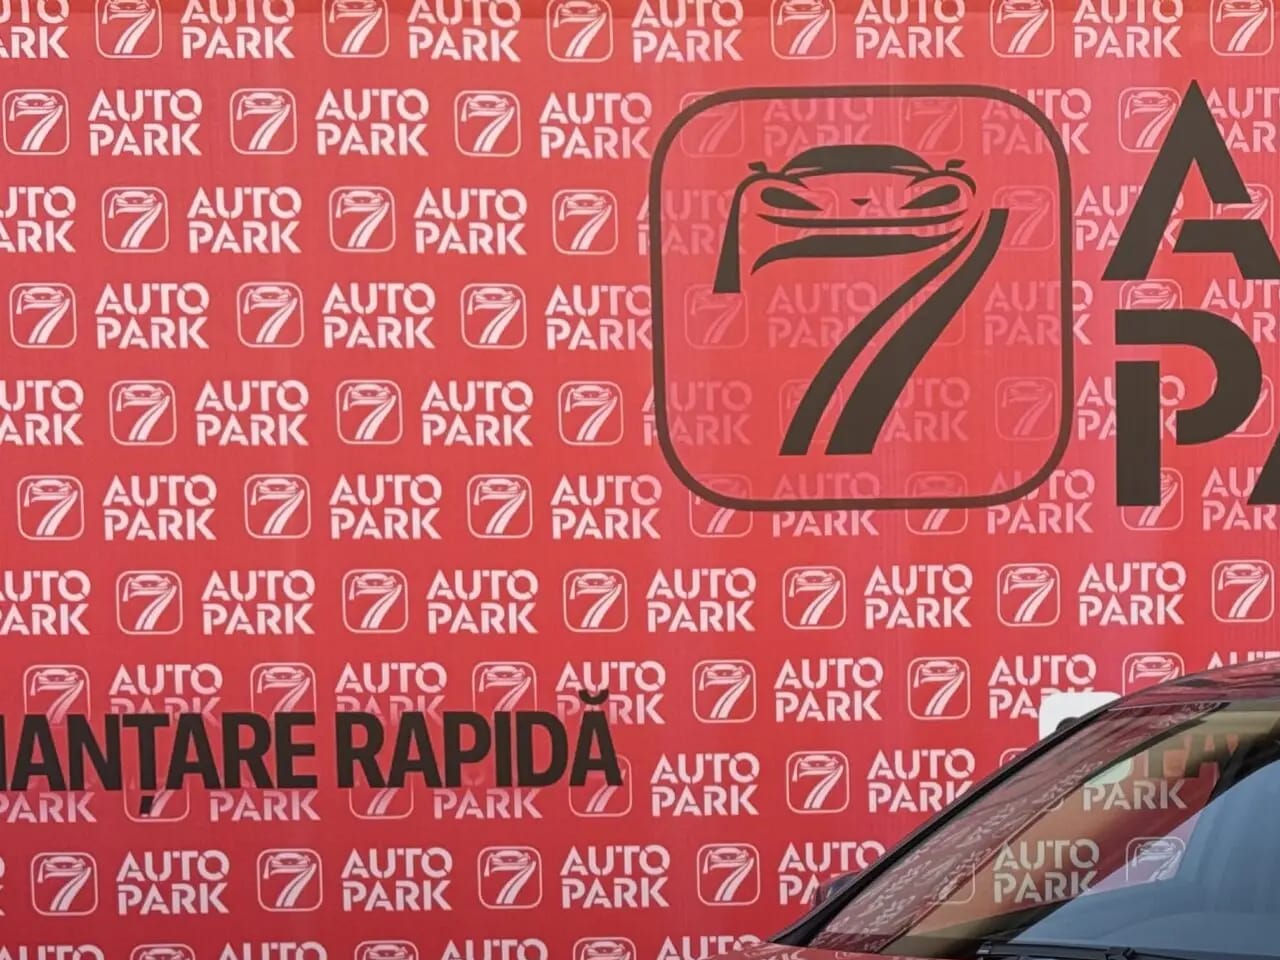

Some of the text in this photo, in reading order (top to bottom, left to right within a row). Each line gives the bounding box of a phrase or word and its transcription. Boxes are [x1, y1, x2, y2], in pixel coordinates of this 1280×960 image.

[180, 0, 295, 24] AUTO
[407, 0, 521, 28] AUTO
[631, 0, 743, 28] AUTO
[854, 0, 965, 24] AUTO
[1072, 0, 1183, 23] AUTO
[182, 26, 294, 59] PARK
[409, 26, 520, 62] PARK
[633, 29, 742, 63] PARK
[856, 26, 963, 58] PARK
[1074, 26, 1181, 57] PARK
[88, 89, 202, 121] AUTO
[315, 88, 429, 121] AUTO
[539, 93, 652, 124] AUTO
[90, 123, 201, 156] PARK
[317, 123, 428, 156] PARK
[541, 126, 652, 159] PARK
[187, 186, 301, 219] AUTO
[414, 187, 527, 221] AUTO
[189, 221, 301, 253] PARK
[416, 221, 526, 255] PARK
[95, 282, 209, 315] AUTO
[322, 283, 435, 315] AUTO
[545, 285, 652, 317] AUTO
[97, 317, 209, 349] PARK
[324, 316, 435, 349] PARK
[546, 318, 652, 351] PARK
[195, 380, 309, 412] AUTO
[421, 381, 533, 413] AUTO
[197, 414, 308, 446] PARK
[422, 414, 532, 446] PARK
[103, 474, 217, 507] AUTO
[329, 474, 442, 506] AUTO
[551, 475, 662, 506] AUTO
[104, 508, 216, 540] PARK
[331, 507, 441, 539] PARK
[552, 508, 660, 539] PARK
[201, 570, 315, 601] AUTO
[426, 569, 538, 601] AUTO
[646, 568, 756, 599] AUTO
[864, 564, 972, 596] AUTO
[1078, 561, 1186, 592] AUTO
[203, 603, 314, 635] PARK
[428, 602, 538, 634] PARK
[648, 600, 755, 632] PARK
[866, 596, 971, 629] PARK
[1079, 594, 1184, 626] PARK
[109, 663, 223, 695] AUTO
[335, 662, 447, 693] AUTO
[774, 657, 883, 689] AUTO
[988, 654, 1096, 686] AUTO
[776, 690, 882, 722] PARK
[0, 689, 623, 817] ANȚARE RAPIDĂ
[650, 752, 760, 784] AUTO
[867, 748, 976, 780] AUTO
[210, 789, 320, 821] PARK
[433, 788, 543, 819] PARK
[652, 784, 759, 816] PARK
[1083, 779, 1188, 811] PARK
[116, 850, 229, 882] AUTO
[341, 847, 452, 879] AUTO
[560, 845, 670, 876] AUTO
[993, 839, 1100, 872] AUTO
[118, 882, 229, 915] PARK
[343, 880, 452, 911] PARK
[562, 877, 669, 908] PARK
[993, 871, 1098, 904] PARK
